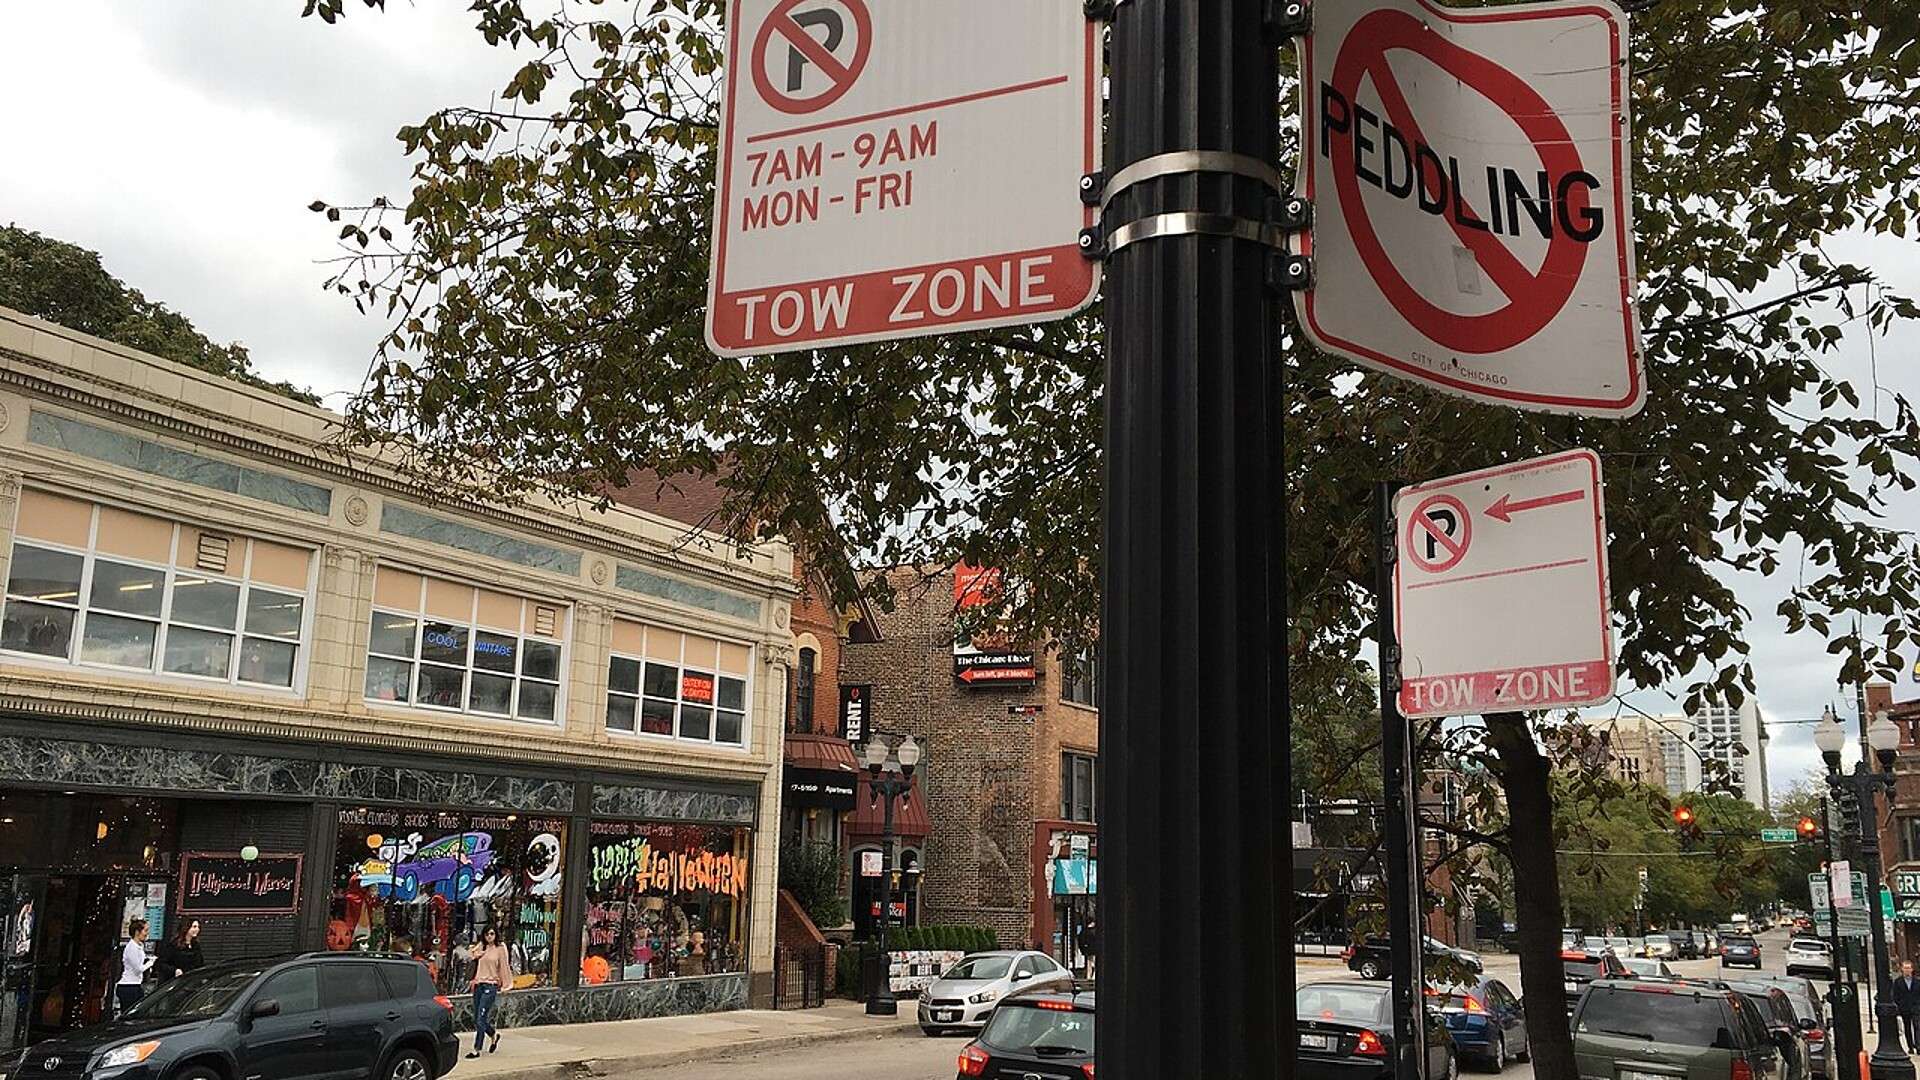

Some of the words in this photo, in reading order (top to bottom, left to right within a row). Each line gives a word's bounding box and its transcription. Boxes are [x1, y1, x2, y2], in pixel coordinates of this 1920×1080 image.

[1320, 80, 1604, 243] PEDDLING
[736, 282, 854, 340] TOW
[888, 254, 1055, 324] ZONE
[1411, 352, 1433, 367] CITY
[1440, 361, 1453, 373] OF
[1460, 367, 1508, 385] CHICAGO
[427, 632, 459, 649] COOL
[1409, 676, 1476, 709] TOW
[1496, 665, 1590, 702] ZONE
[189, 871, 252, 897] Hollywood
